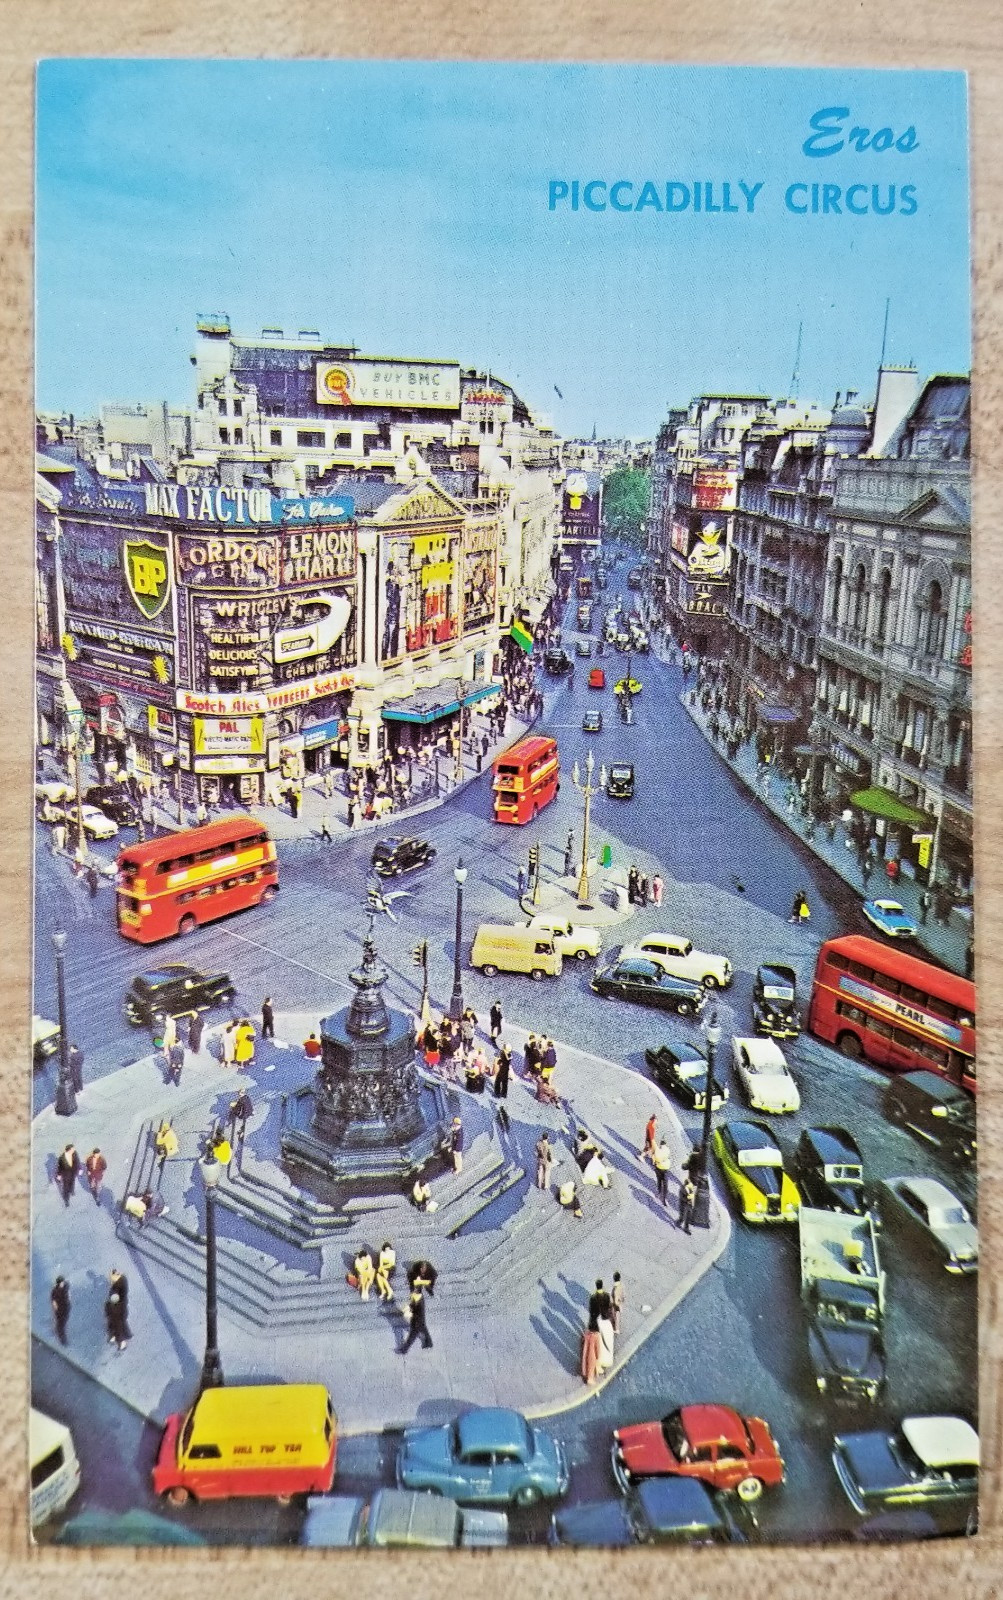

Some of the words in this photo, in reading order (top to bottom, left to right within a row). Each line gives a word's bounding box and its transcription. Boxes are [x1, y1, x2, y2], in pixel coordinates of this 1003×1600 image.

[803, 106, 920, 157] Eros
[548, 179, 765, 213] PICCADILLY
[785, 184, 919, 215] CIRCUS
[372, 372, 402, 383] BUY
[408, 373, 440, 386] BMC
[360, 387, 452, 401] VEHICLES
[144, 482, 179, 518] MAX
[186, 486, 272, 523] FACTOR
[290, 529, 353, 559] LEMON
[131, 555, 166, 597] BP
[209, 650, 257, 661] DELICIOUS
[185, 694, 226, 714] Scotch
[219, 721, 240, 733] PAL
[895, 1003, 925, 1026] PEARL
